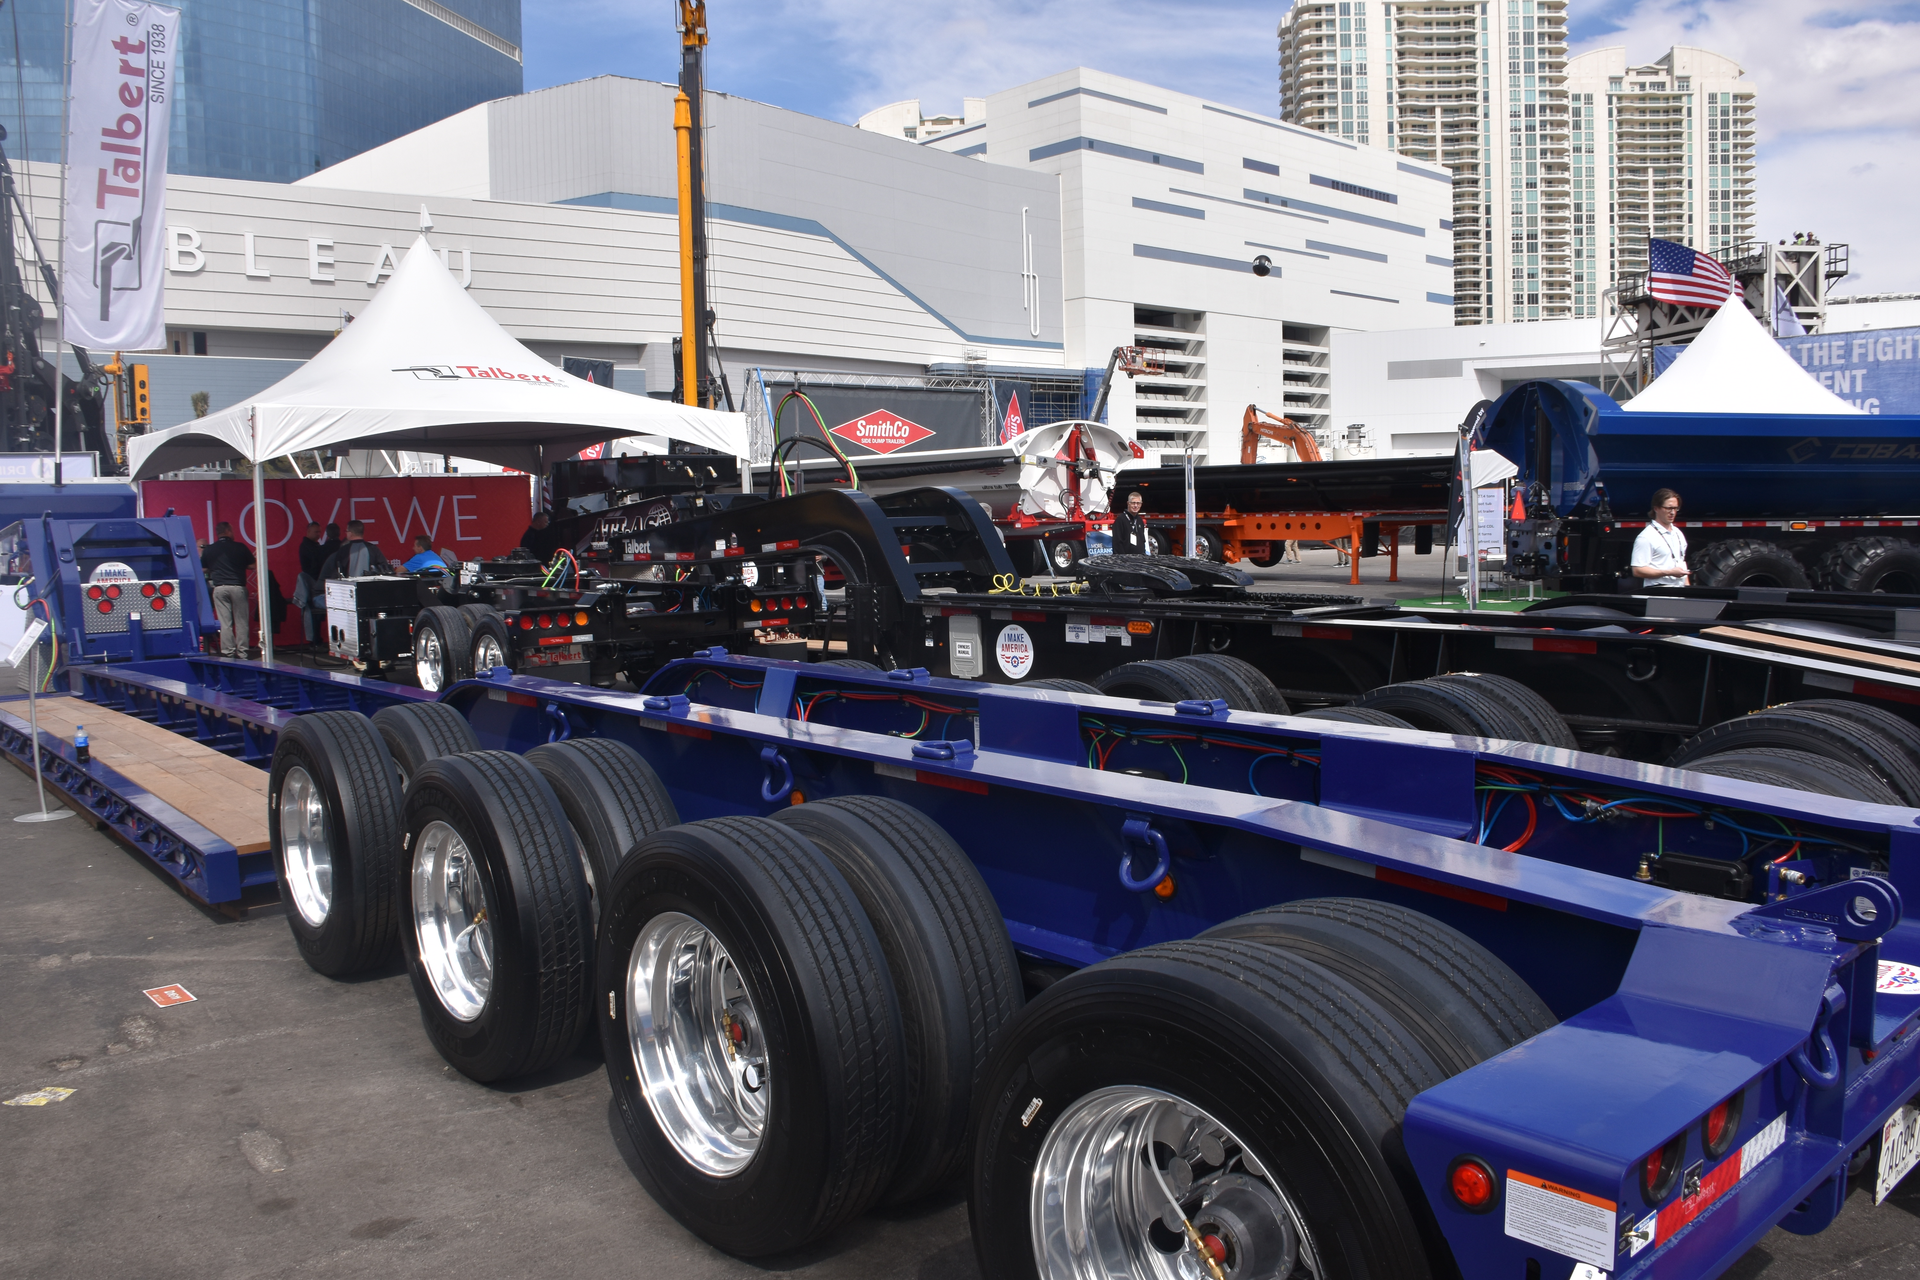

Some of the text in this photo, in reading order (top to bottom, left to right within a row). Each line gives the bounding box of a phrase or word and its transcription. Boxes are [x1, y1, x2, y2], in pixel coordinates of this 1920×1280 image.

[150, 23, 166, 104] SINCE 1938
[96, 35, 146, 210] Talbert
[1797, 340, 1846, 367] THE
[456, 365, 555, 384] Talbert
[856, 420, 910, 438] SmithCo
[622, 538, 651, 554] Talbert
[104, 568, 127, 578] MAKE
[1007, 632, 1025, 643] MAKE
[547, 652, 582, 663] Talbert
[1547, 1184, 1581, 1199] WARNING
